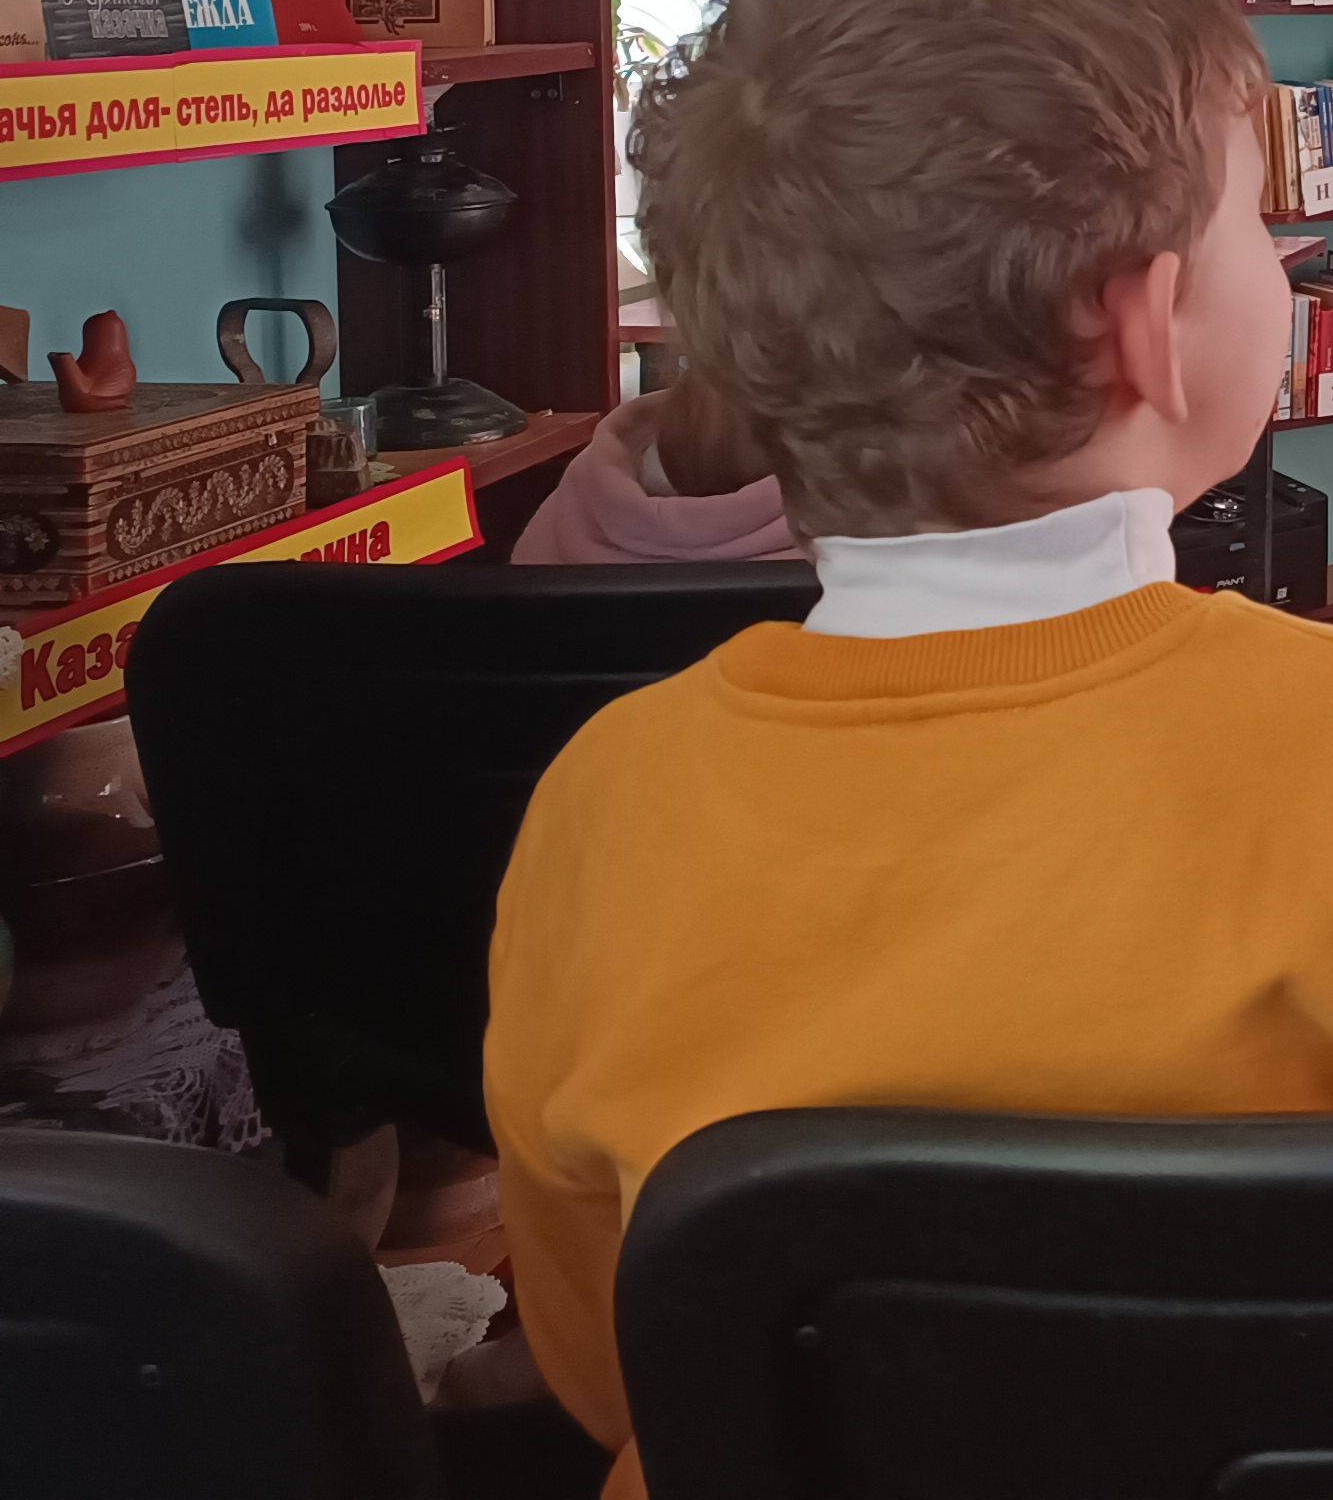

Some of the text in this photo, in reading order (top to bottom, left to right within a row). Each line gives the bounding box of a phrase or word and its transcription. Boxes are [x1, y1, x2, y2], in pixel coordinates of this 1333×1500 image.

[0, 78, 406, 144] ачья доля- степь, да раздолье
[1316, 184, 1331, 200] Н
[20, 520, 391, 712] Каза рина
